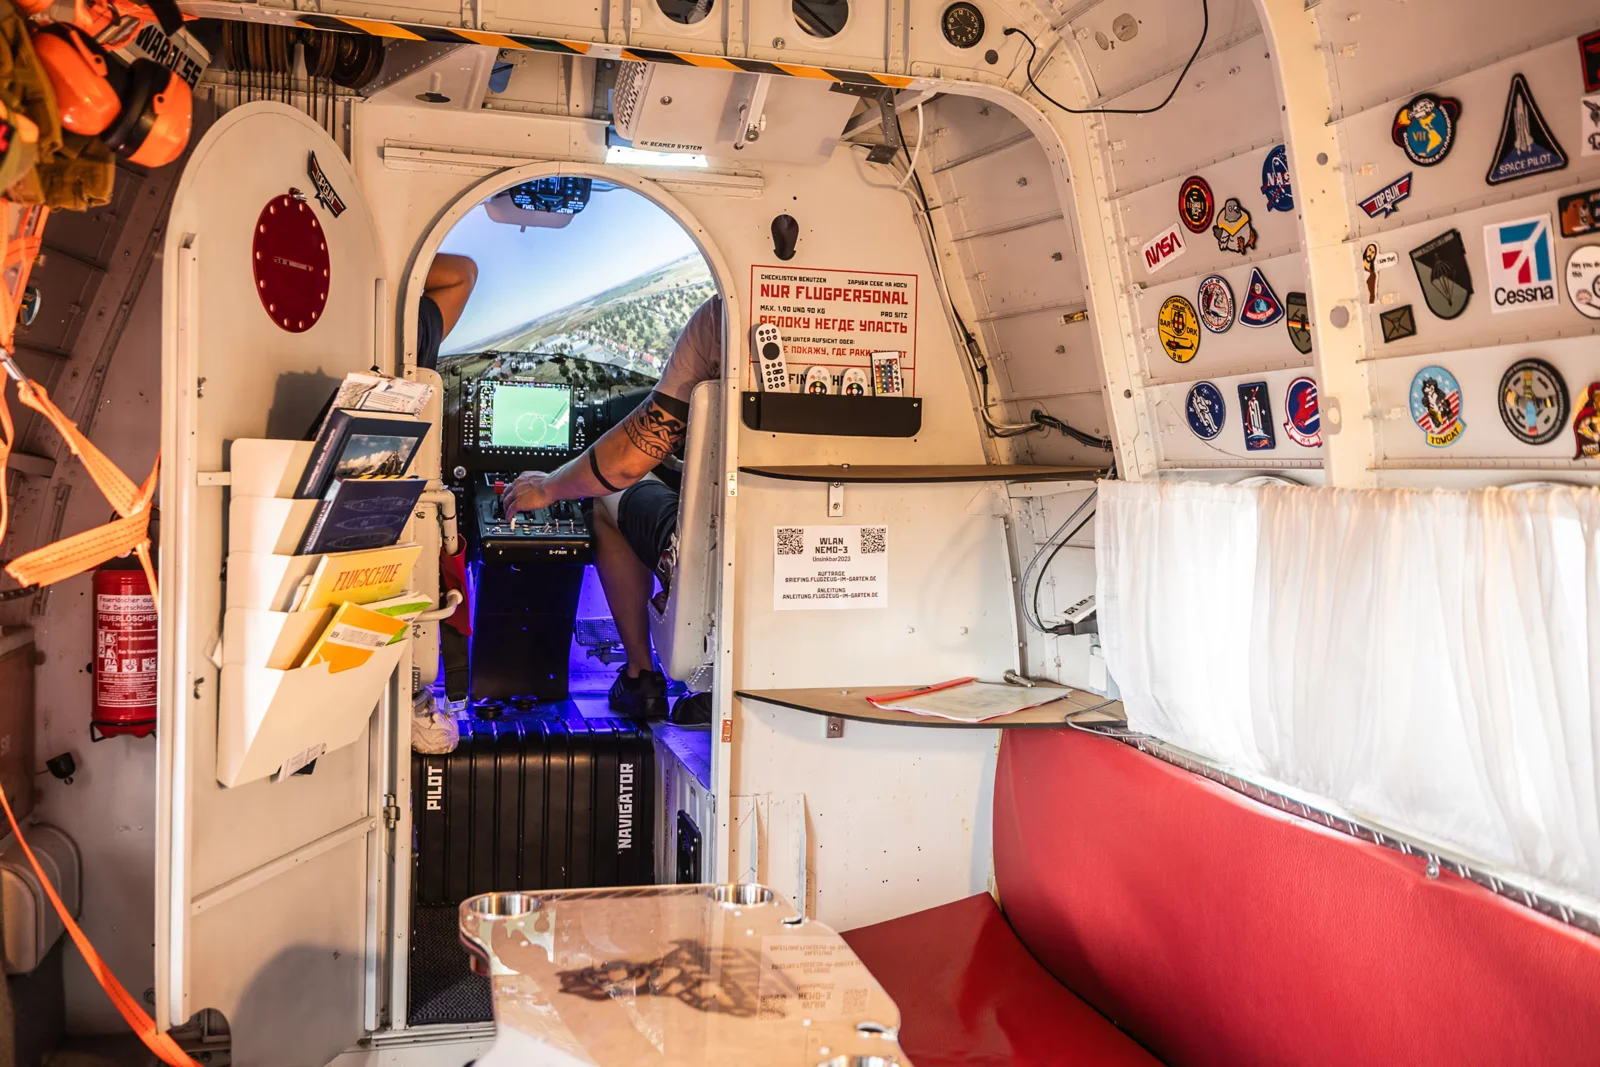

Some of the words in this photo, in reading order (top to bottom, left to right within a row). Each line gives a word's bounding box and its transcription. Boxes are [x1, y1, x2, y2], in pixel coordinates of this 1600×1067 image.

[1498, 159, 1526, 175] SPACE
[1526, 153, 1553, 168] PILOT
[1267, 173, 1290, 186] NAS
[1374, 192, 1386, 209] TOP
[1384, 185, 1401, 202] GUN
[1145, 232, 1181, 268] NASA
[761, 283, 790, 298] NUR
[796, 286, 908, 305] FLUGPERSONAL
[1495, 285, 1554, 305] Cessna
[815, 318, 855, 332] НЕГДЕ
[860, 320, 907, 333] УПАСТЬ
[1160, 319, 1171, 328] SAR
[1186, 327, 1197, 336] DRK
[832, 347, 846, 356] ГДЕ
[1429, 428, 1459, 446] TOMCAT
[426, 766, 443, 811] PILOT
[618, 763, 634, 849] NAVIGATOR
